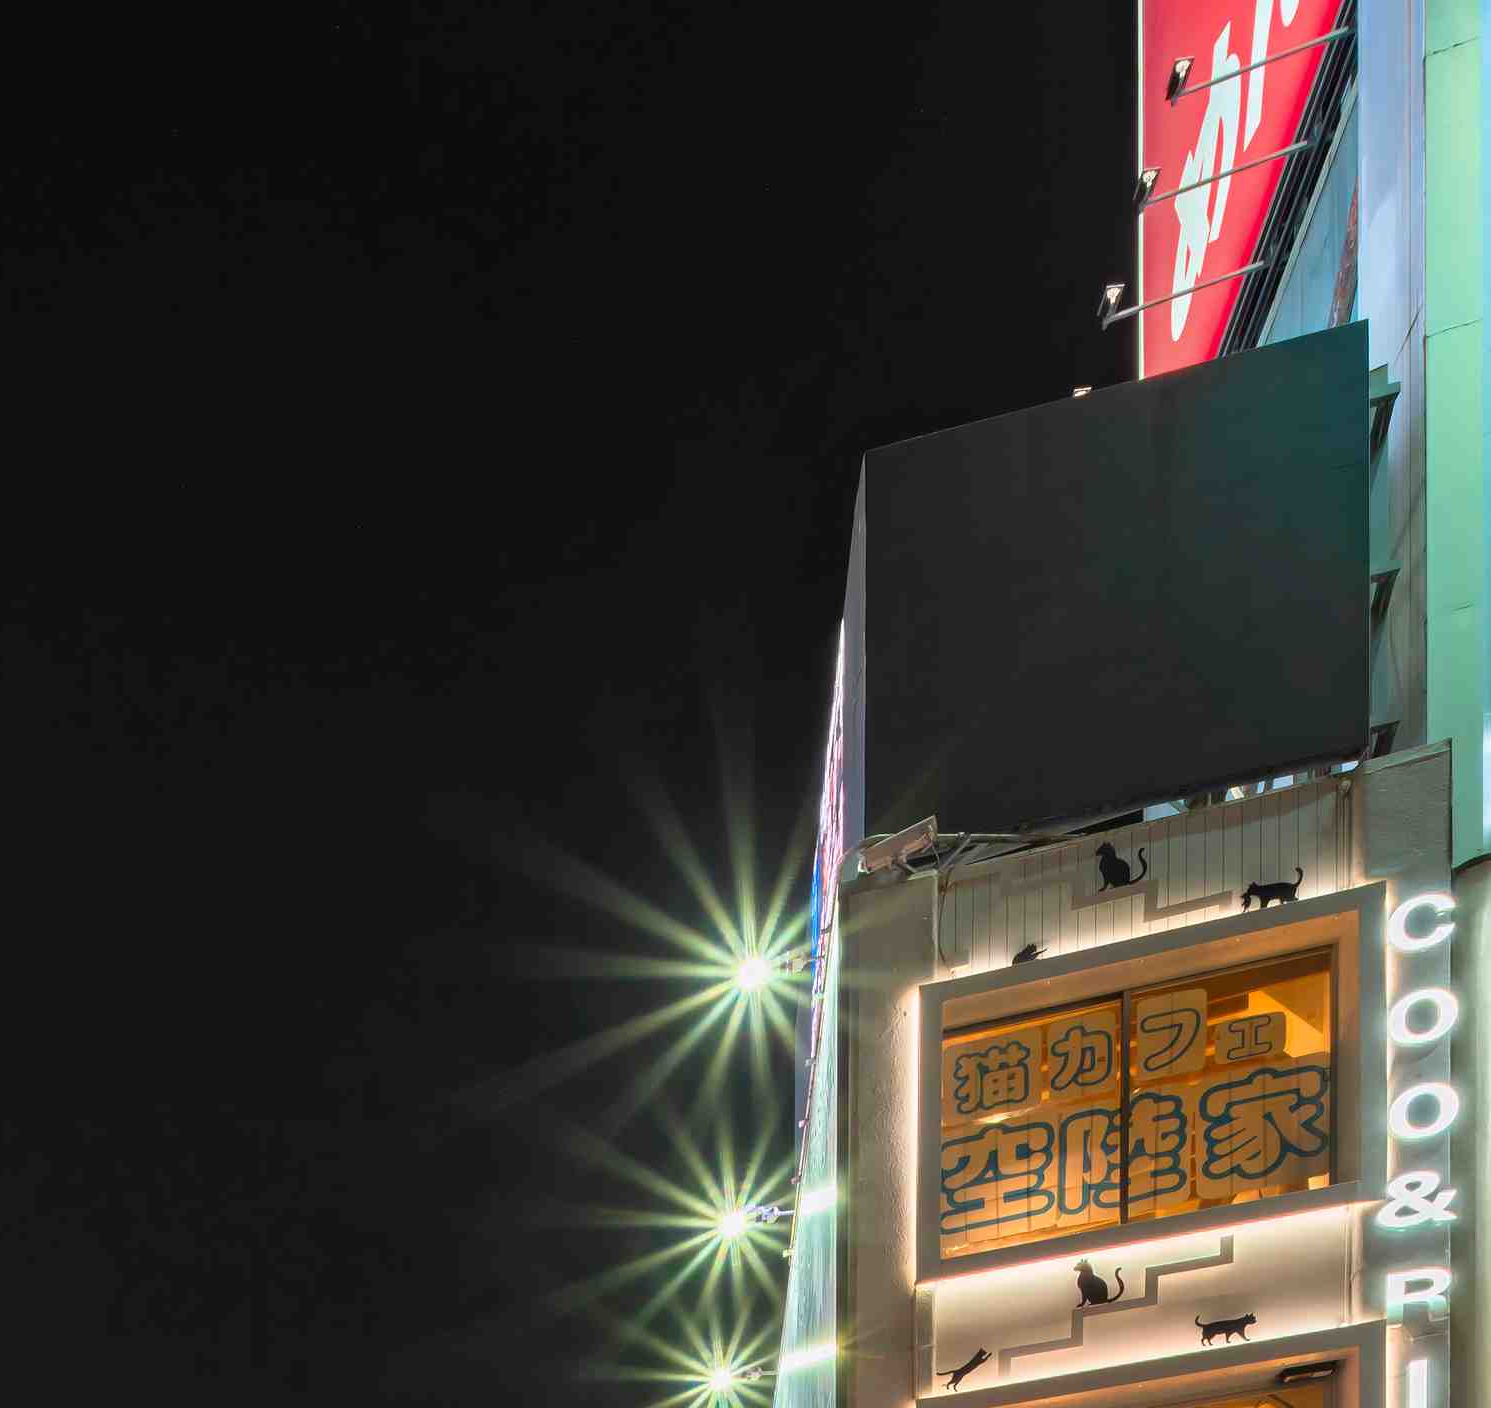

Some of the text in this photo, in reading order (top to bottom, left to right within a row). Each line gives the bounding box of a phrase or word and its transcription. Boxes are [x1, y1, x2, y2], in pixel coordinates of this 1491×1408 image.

[953, 1006, 1277, 1115] 猫カフェ
[940, 1066, 1331, 1236] 空陸家
